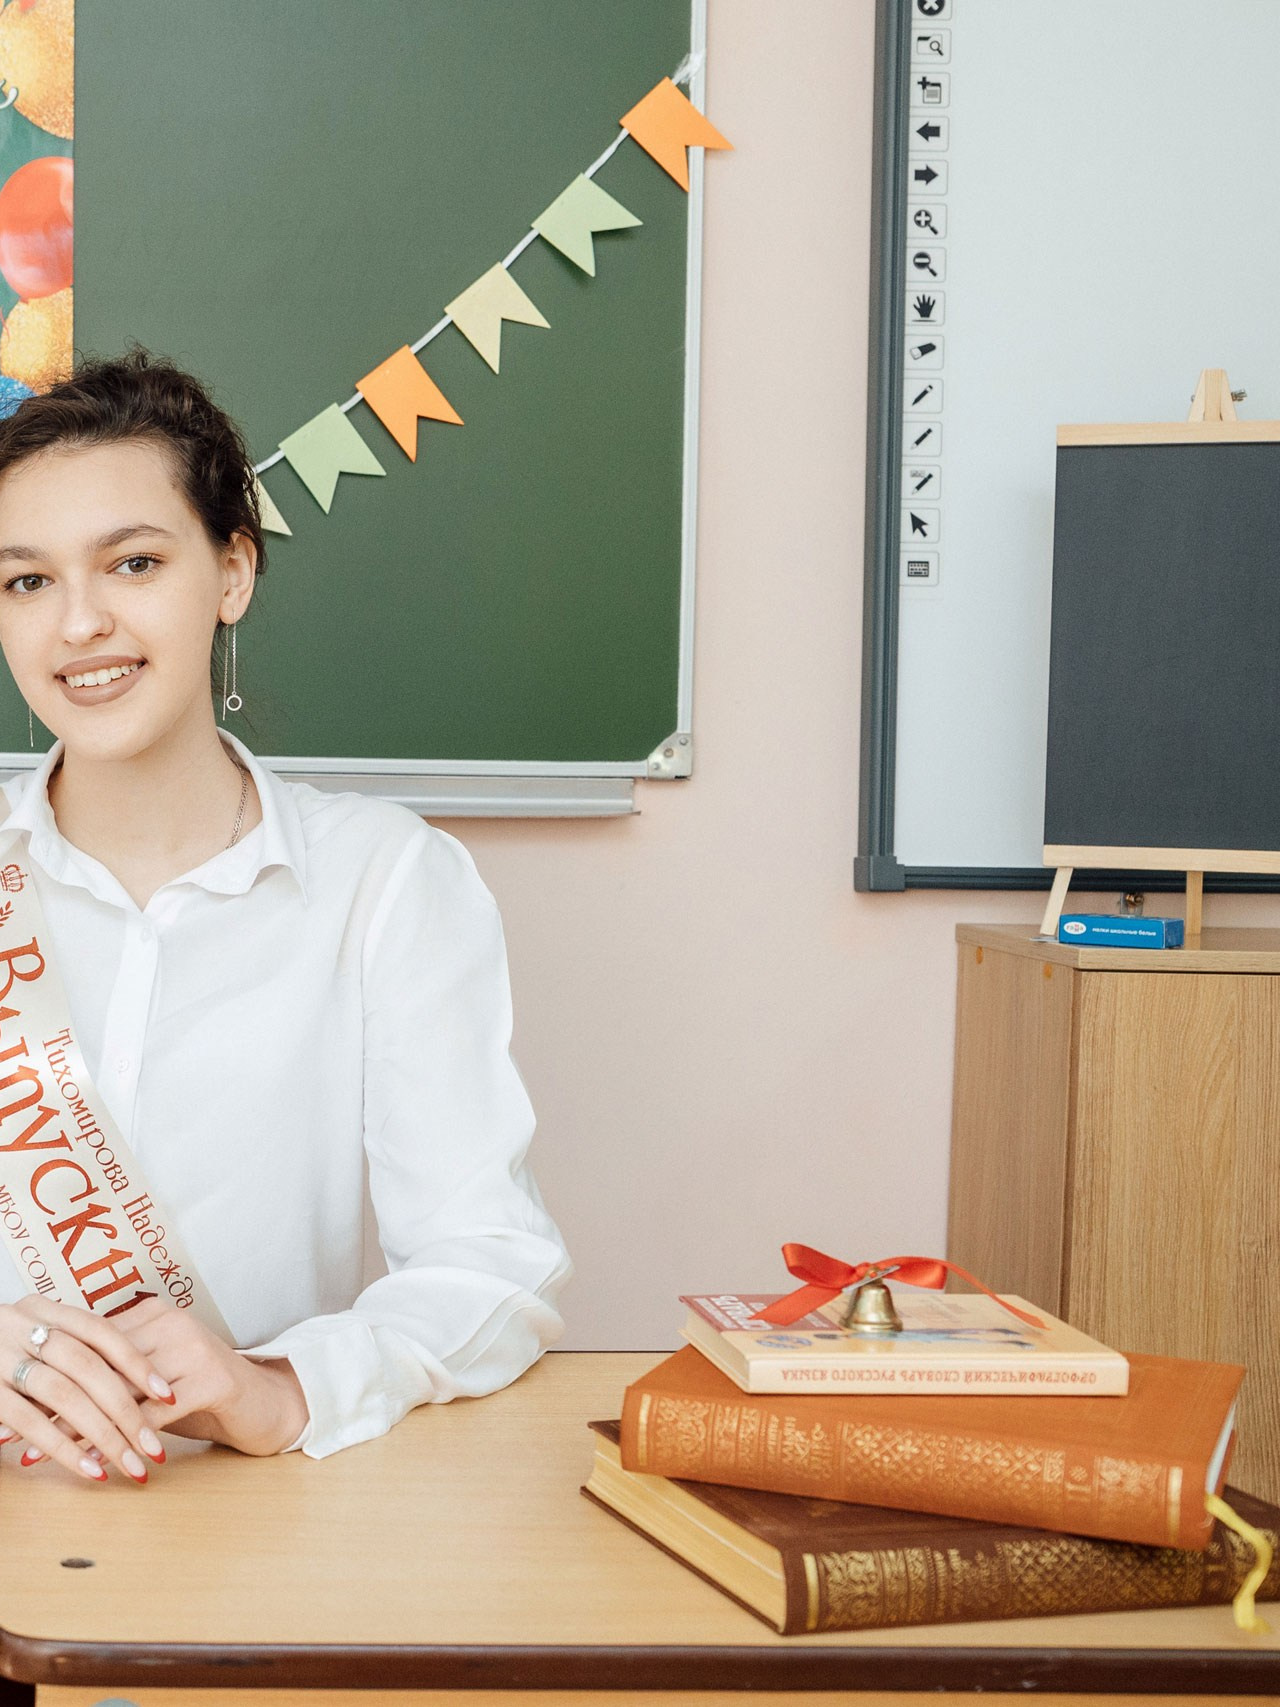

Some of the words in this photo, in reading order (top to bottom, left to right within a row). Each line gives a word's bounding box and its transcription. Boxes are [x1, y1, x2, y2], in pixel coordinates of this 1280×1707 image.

[42, 1027, 130, 1195] Тихомирова
[121, 1192, 195, 1309] Надежда
[21, 1245, 56, 1295] СОШ
[781, 1368, 827, 1382] ЯЗЫКА
[831, 1368, 896, 1382] РУССКОГО
[900, 1369, 960, 1383] СЛОВАРЬ
[962, 1369, 1097, 1385] ОРФОГРАФИЧЕСКИЙ
